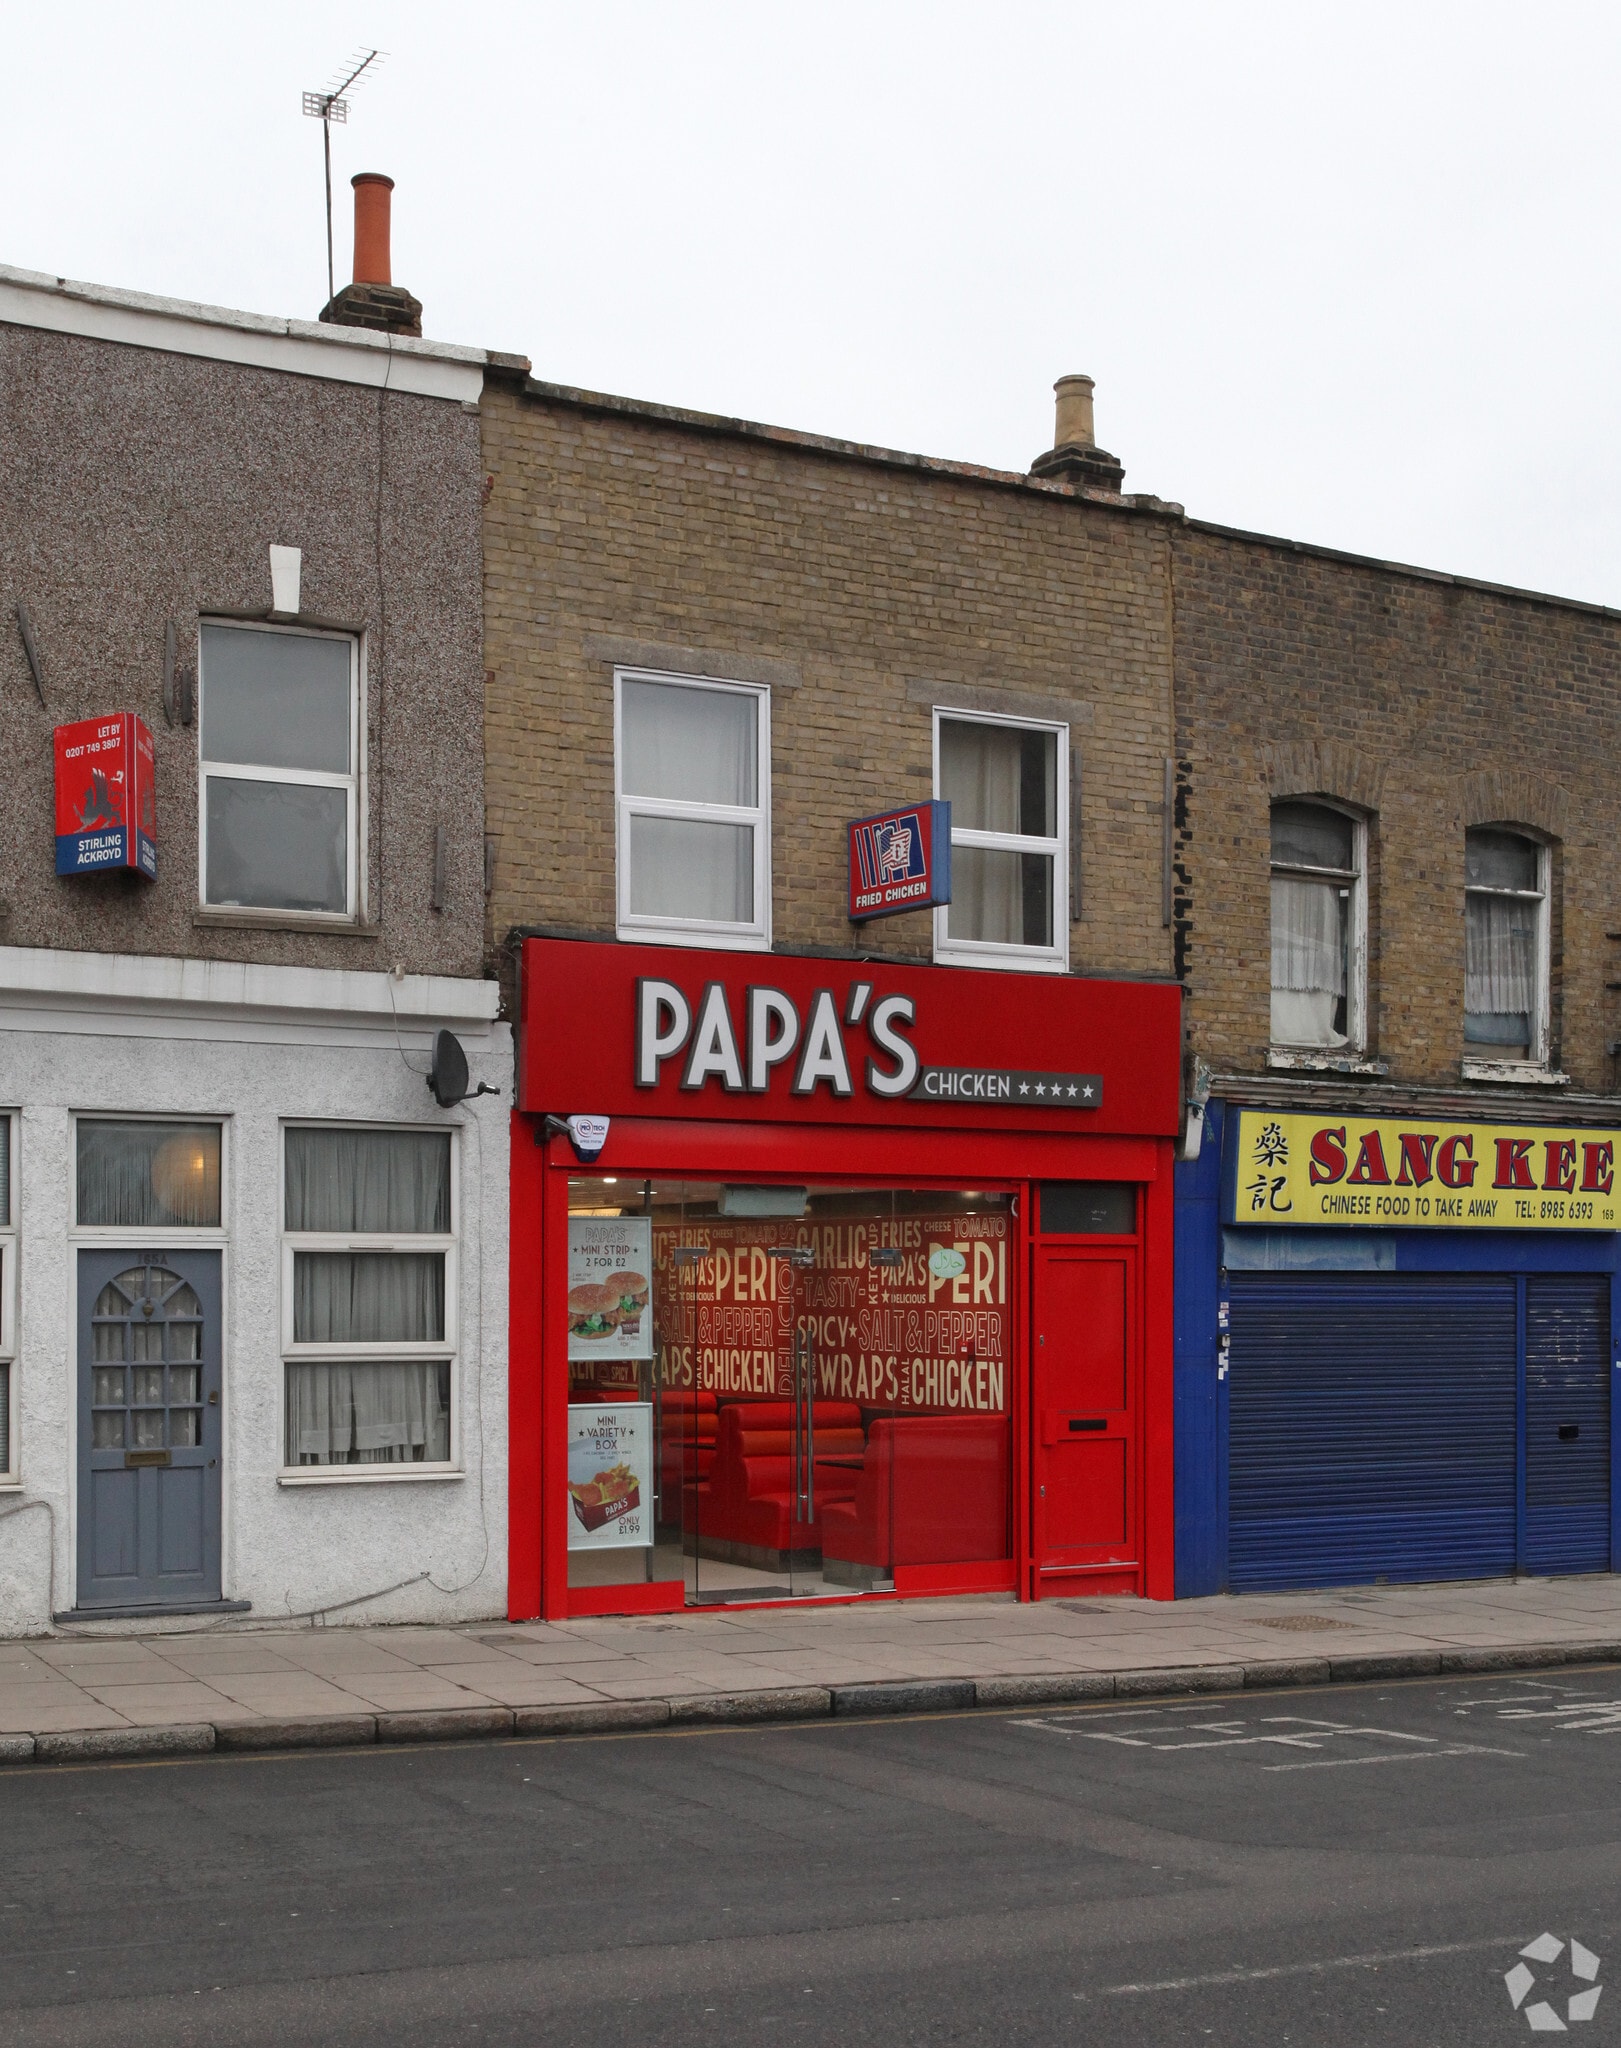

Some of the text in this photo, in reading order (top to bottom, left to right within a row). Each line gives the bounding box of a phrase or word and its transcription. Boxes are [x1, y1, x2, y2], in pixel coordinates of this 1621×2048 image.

[98, 723, 121, 738] LET BY
[66, 737, 121, 758] 0207 749 3807
[78, 834, 122, 852] STIRLING
[77, 847, 122, 865] ACKROYD
[856, 881, 927, 909] FRIED CHICKEN
[635, 976, 918, 1097] PAPA'S
[924, 1072, 1011, 1098] CHICKEN
[1309, 1126, 1615, 1196] SANG KEE
[1321, 1194, 1594, 1221] CHINESE FOOD TO TAKE AWAY TEL: 8985 6393
[1602, 1208, 1615, 1221] 169
[585, 1226, 627, 1243] PAPA'S
[712, 1229, 734, 1239] CHEESE
[735, 1226, 777, 1244] TOMATO
[881, 1221, 921, 1248] FRIES
[924, 1221, 951, 1233] CHEESE
[953, 1216, 1006, 1238] TOMATO
[581, 1244, 631, 1255] MINI STRIP
[797, 1224, 867, 1270] GARLIC
[586, 1256, 626, 1267] 2 FOR £2
[868, 1223, 878, 1305] KETCUP
[716, 1247, 777, 1302] PERI
[928, 1240, 1006, 1305] PERI
[890, 1293, 926, 1304] DELICIOUS
[661, 1306, 773, 1347] SALT & PEPPER
[858, 1309, 905, 1353] SALT
[905, 1310, 923, 1353] &
[924, 1310, 1002, 1357] PEPPER
[703, 1348, 775, 1394] CHICKEN
[819, 1353, 898, 1401] WRAPS
[901, 1357, 910, 1405] HALAL
[912, 1357, 1004, 1411] CHICKEN
[597, 1416, 617, 1426] MINI
[586, 1427, 627, 1438] VARIETY
[596, 1439, 618, 1450] BOX
[605, 1497, 629, 1517] PAPA'S
[618, 1517, 640, 1525] ONLY
[618, 1524, 640, 1535] £1.99
